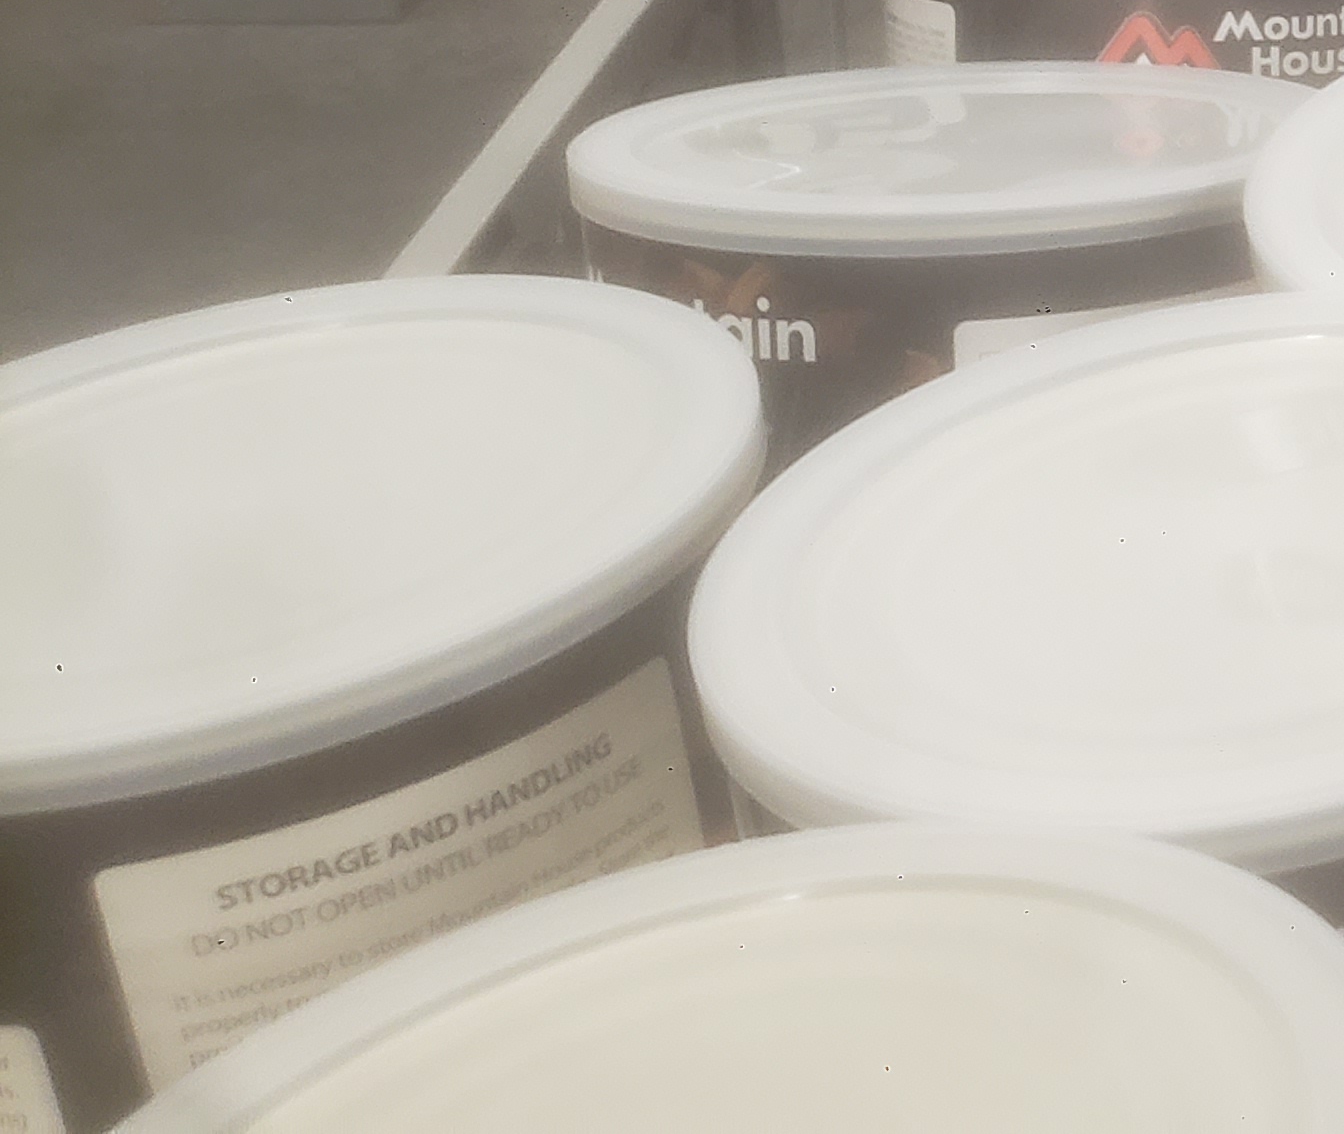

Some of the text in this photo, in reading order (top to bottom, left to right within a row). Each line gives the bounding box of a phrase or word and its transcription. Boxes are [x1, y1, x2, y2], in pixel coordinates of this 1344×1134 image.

[190, 926, 240, 958] DO
[245, 906, 308, 941] NOT
[315, 877, 397, 923] OPEN
[403, 846, 484, 894] UNTIL
[485, 806, 566, 858] READY
[215, 732, 612, 912] STORAGE AND HANDLING
[219, 960, 333, 1002] necessary
[338, 948, 364, 969] to
